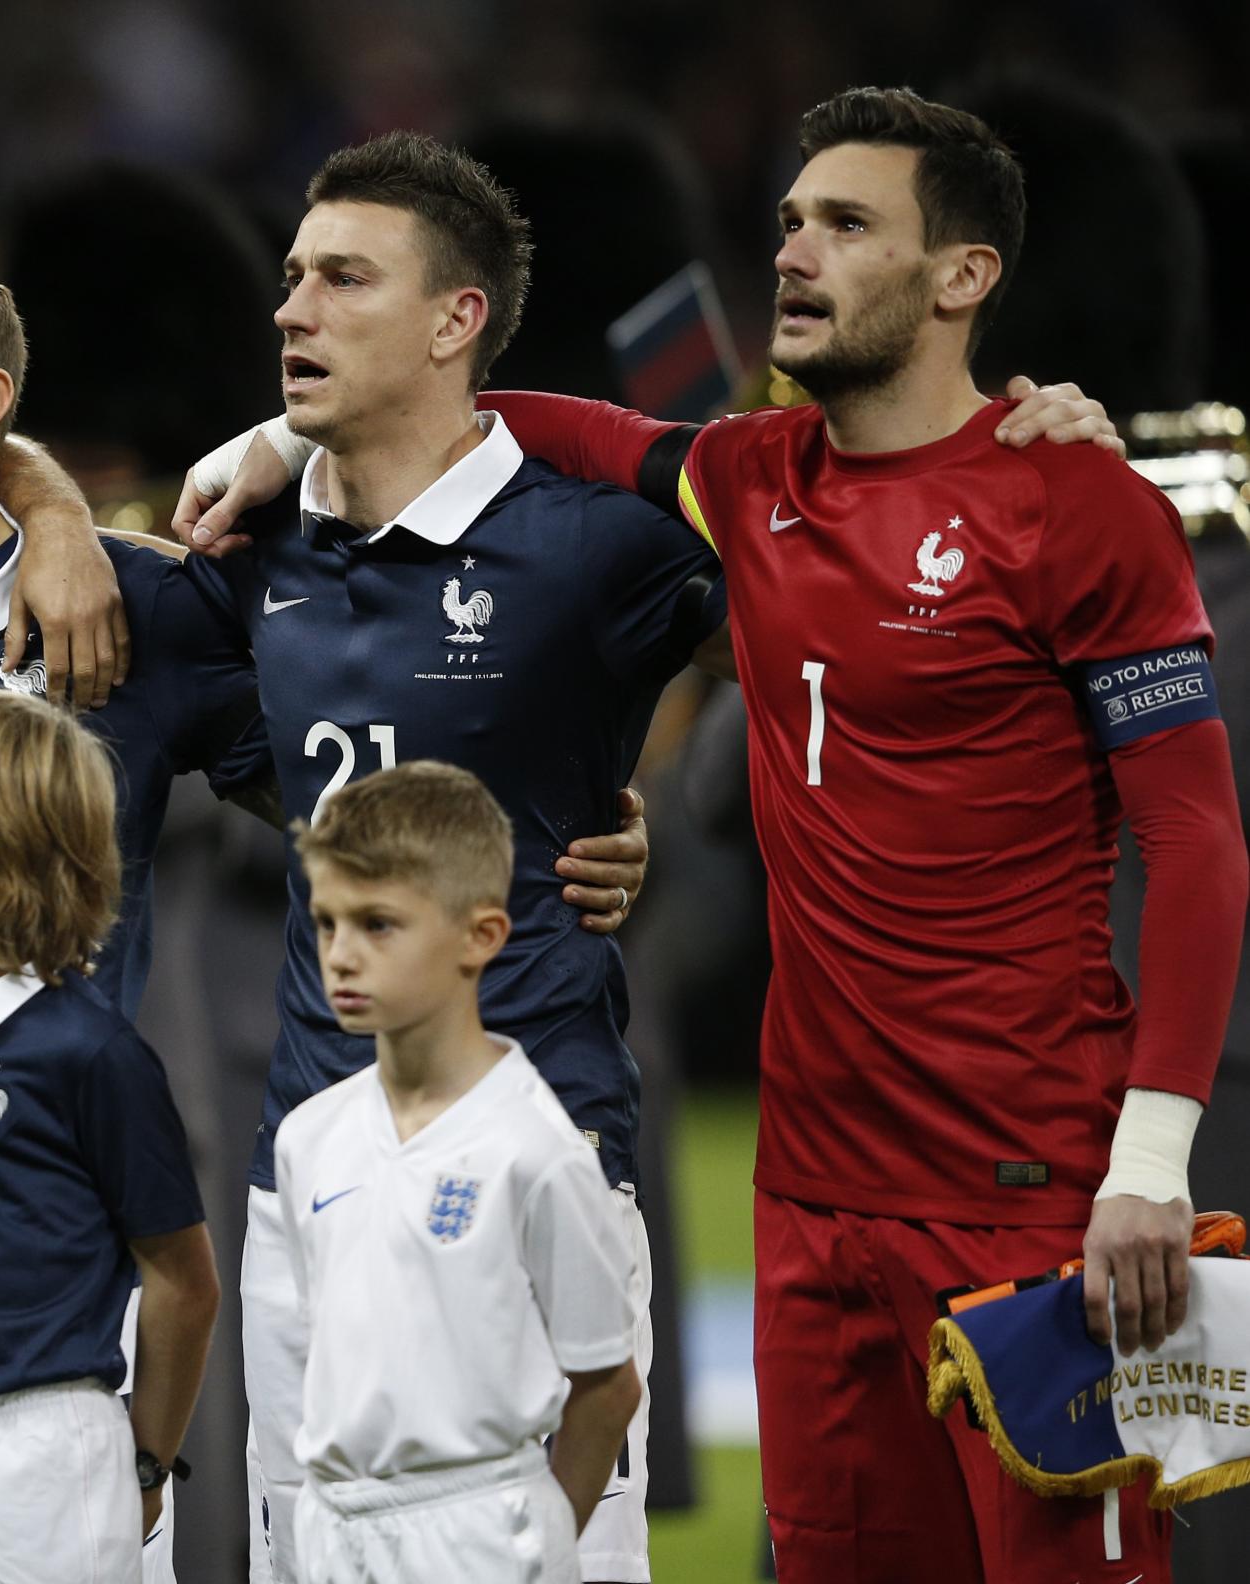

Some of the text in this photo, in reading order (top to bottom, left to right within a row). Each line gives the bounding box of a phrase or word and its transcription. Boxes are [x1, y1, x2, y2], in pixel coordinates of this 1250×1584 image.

[1088, 675, 1112, 695] NO
[1113, 666, 1140, 685] TO
[1142, 650, 1203, 676] RACISM
[1131, 678, 1205, 711] RESPECT
[802, 661, 825, 786] 1
[1066, 1360, 1248, 1424] 17 NOVEMBRE
[1118, 1392, 1250, 1428] LONDRES
